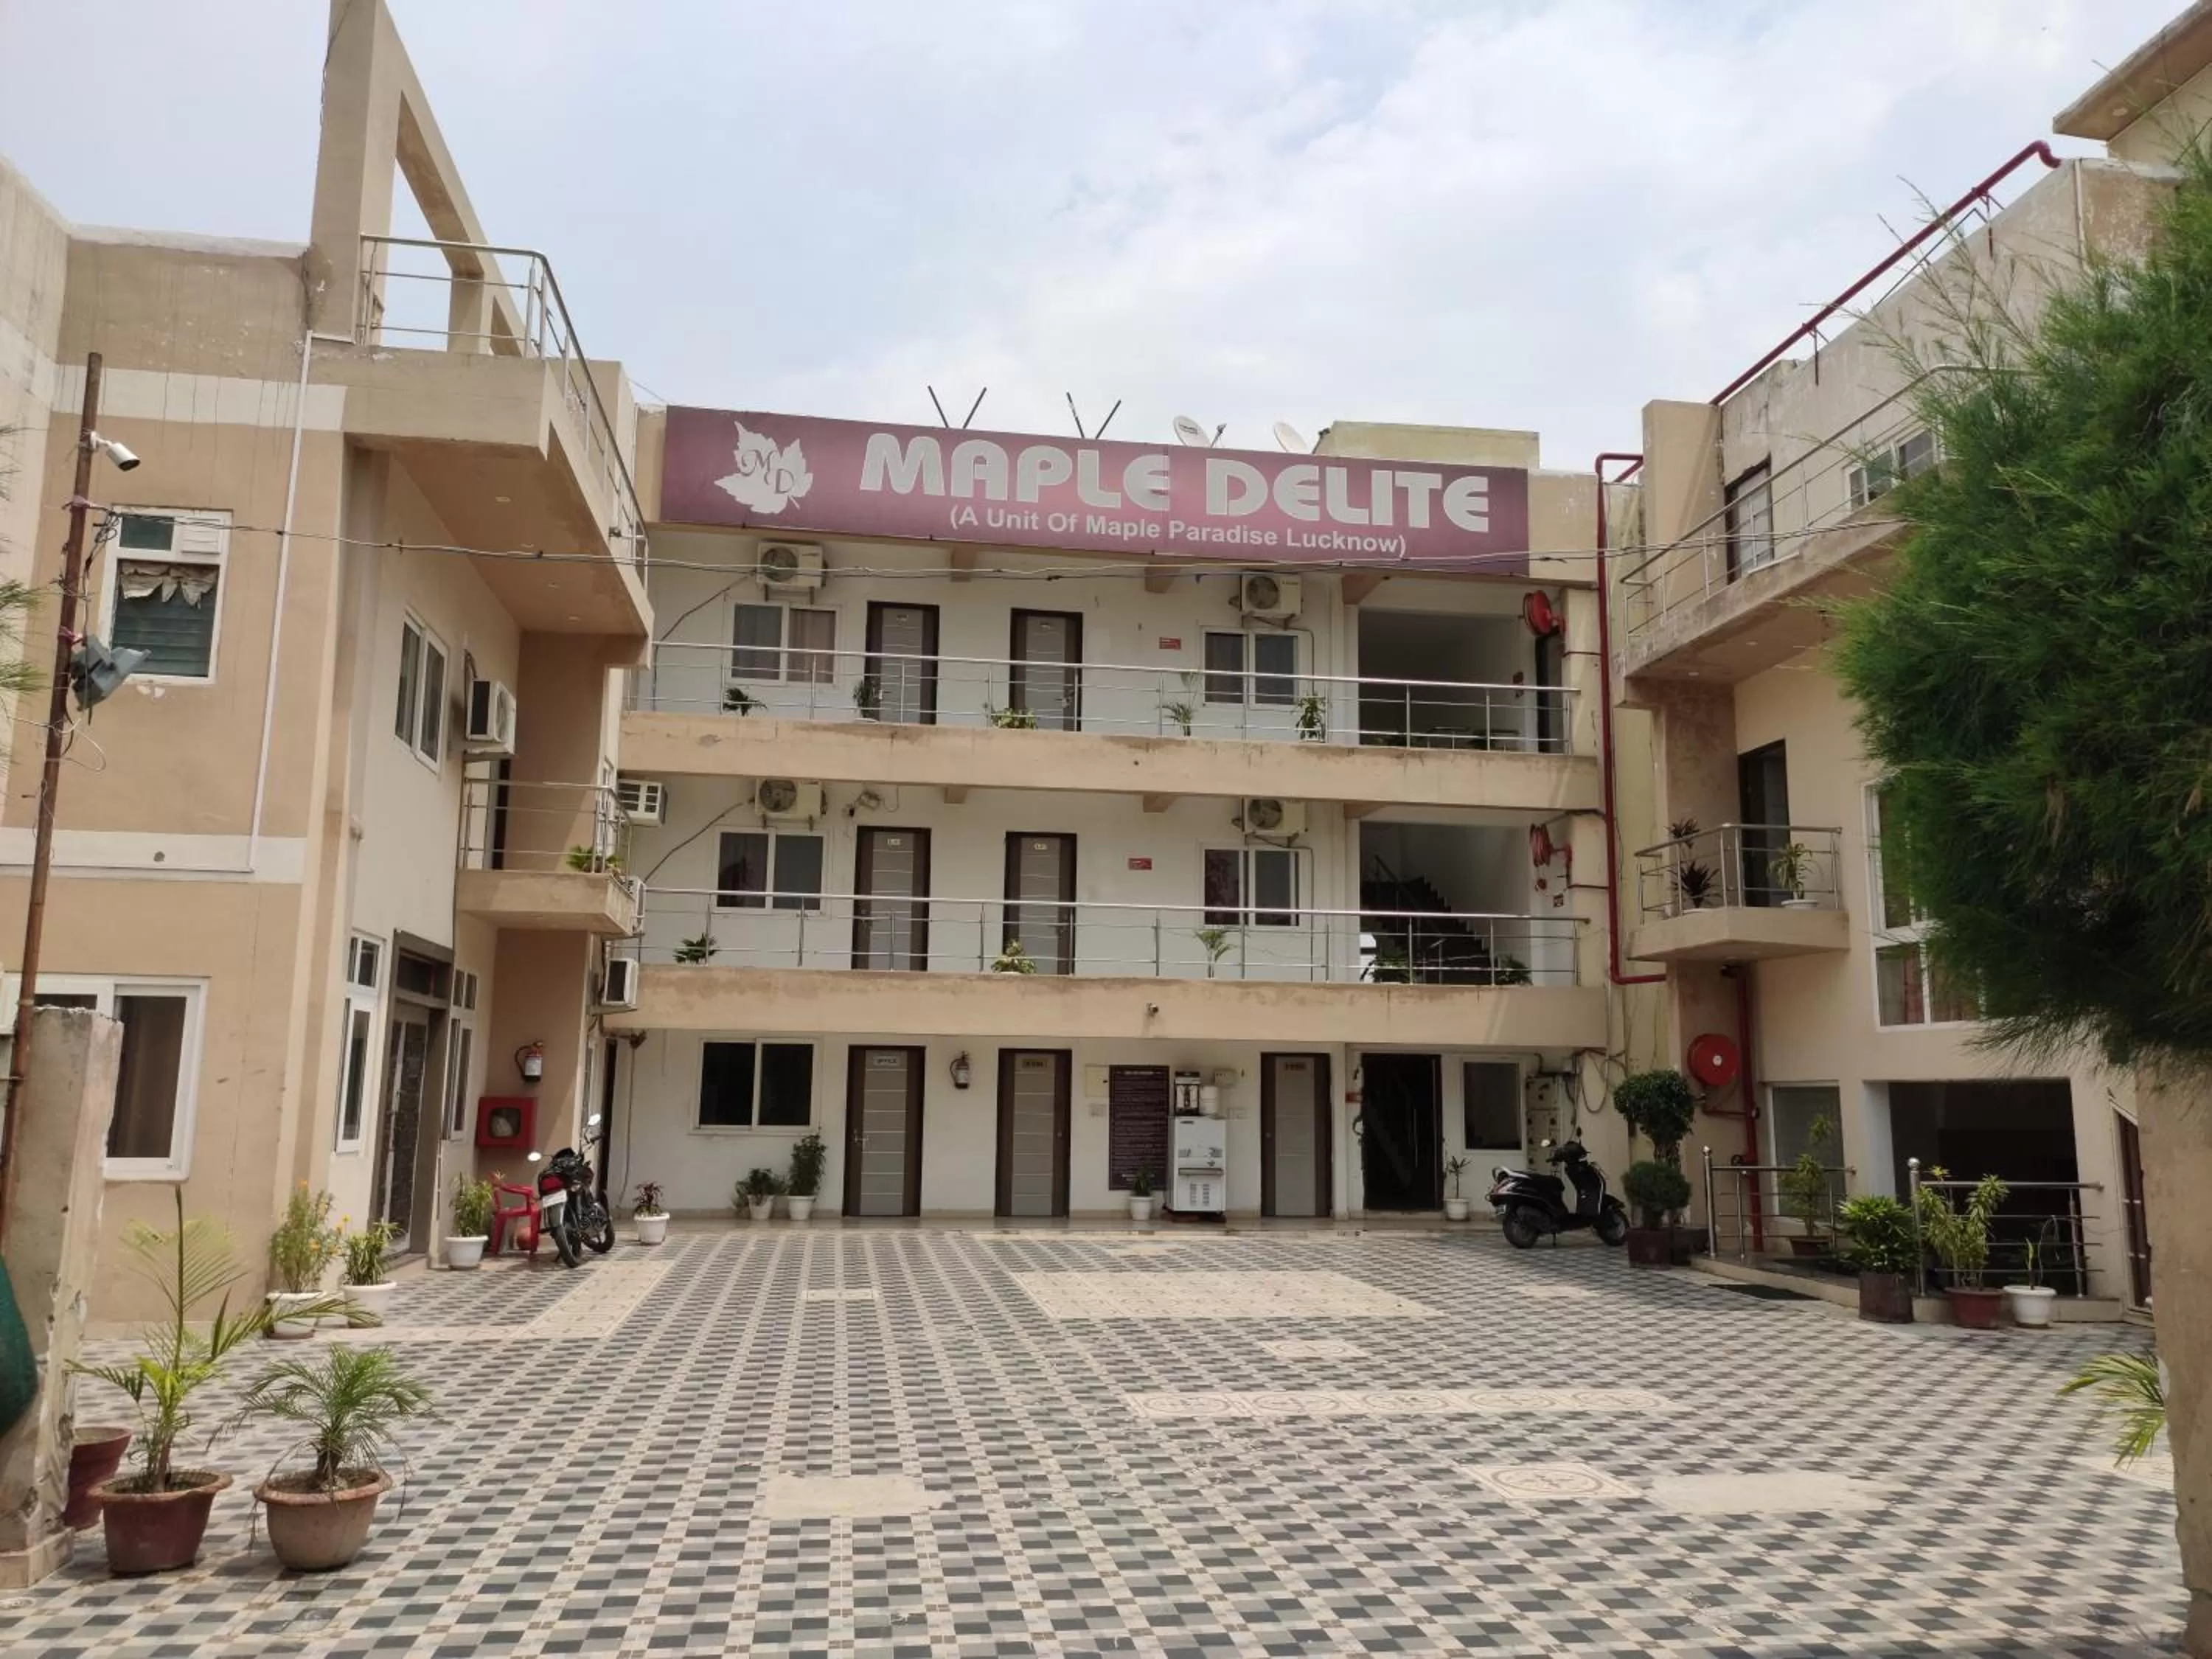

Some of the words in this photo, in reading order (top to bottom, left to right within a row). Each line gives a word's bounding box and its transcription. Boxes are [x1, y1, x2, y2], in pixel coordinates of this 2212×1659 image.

[860, 432, 1171, 512] MAPLE
[1205, 457, 1489, 533] DELITE
[950, 505, 978, 529] (A
[987, 507, 1040, 530] Unit
[1047, 512, 1079, 532] Of
[1086, 515, 1161, 541] Maple
[1168, 520, 1279, 546] Paradise
[1286, 527, 1407, 558] Lucknow)
